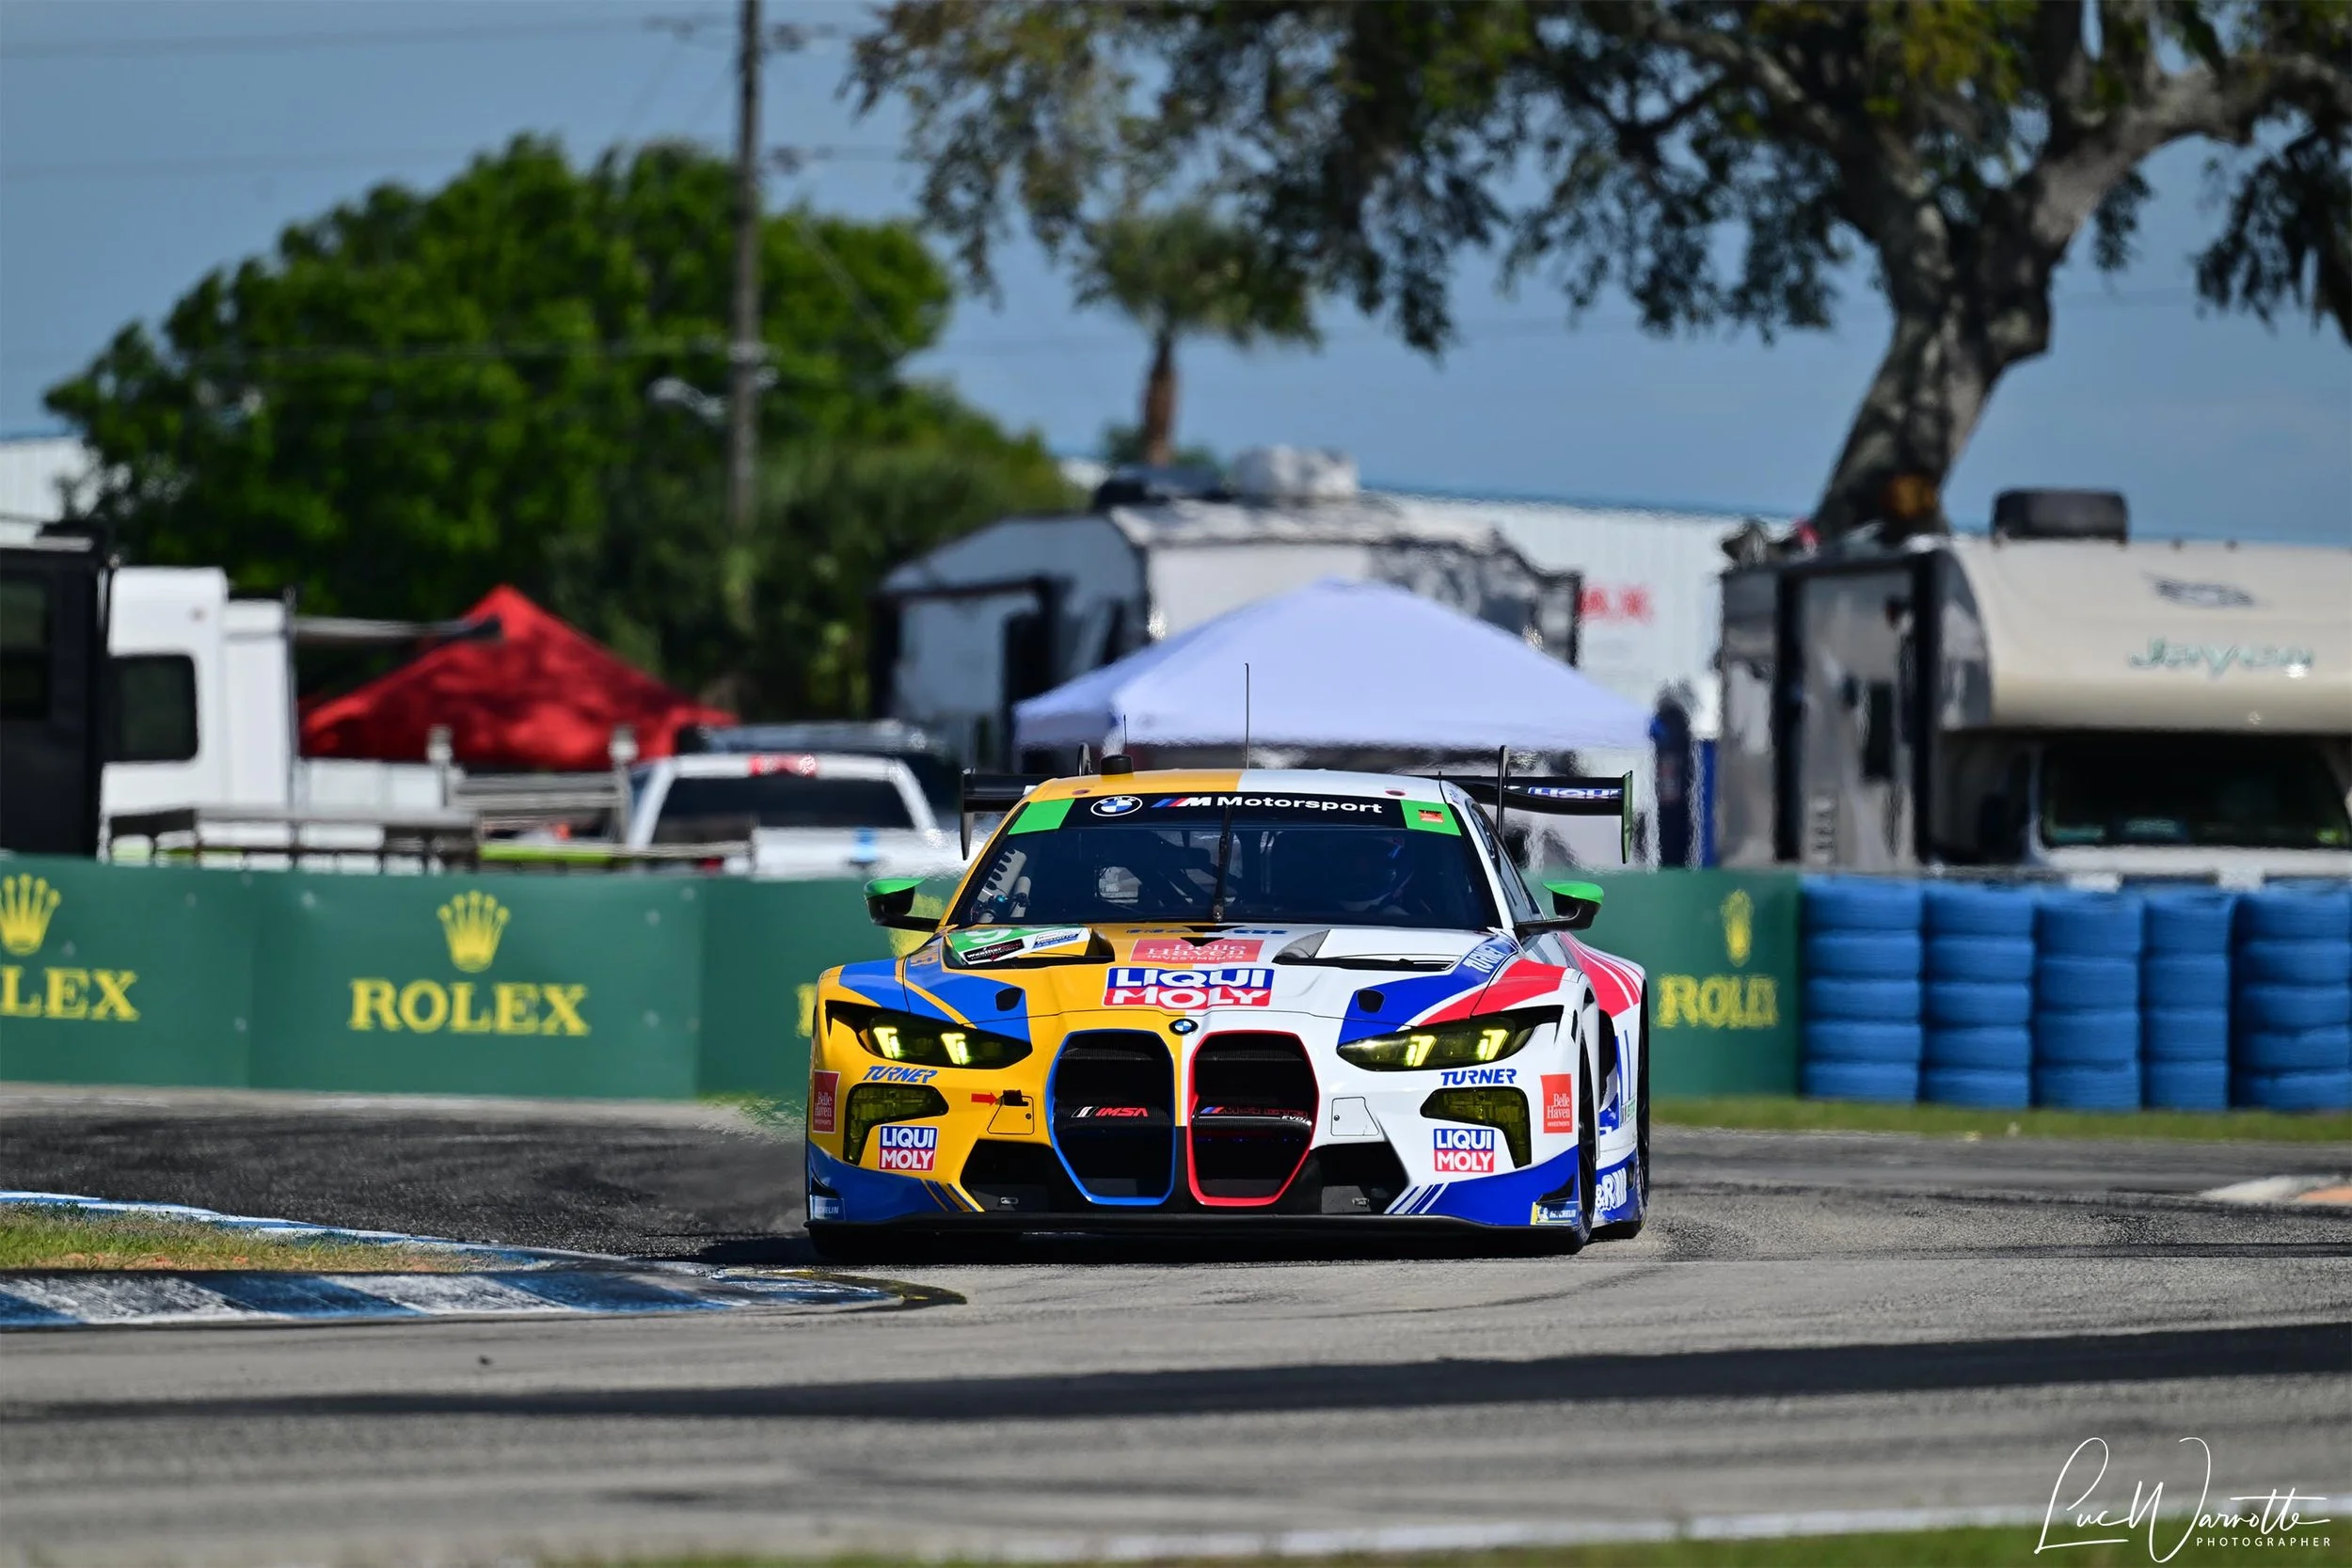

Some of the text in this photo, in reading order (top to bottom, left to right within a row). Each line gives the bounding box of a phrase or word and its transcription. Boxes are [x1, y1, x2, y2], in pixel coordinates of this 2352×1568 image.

[1217, 796, 1383, 814] Motorsport
[1116, 969, 1266, 989] LIQUI
[347, 977, 591, 1036] ROLEX
[1112, 989, 1269, 1008] MOLY
[863, 1066, 938, 1084] TURNER
[1440, 1069, 1517, 1085] TURNER
[1553, 1093, 1570, 1106] Belle
[1095, 1107, 1149, 1117] IMSA
[1547, 1106, 1570, 1118] Haven
[882, 1128, 935, 1148] LIQUI
[1436, 1130, 1493, 1150] LIQUI
[881, 1149, 934, 1169] MOLY
[1437, 1151, 1493, 1171] MOLY
